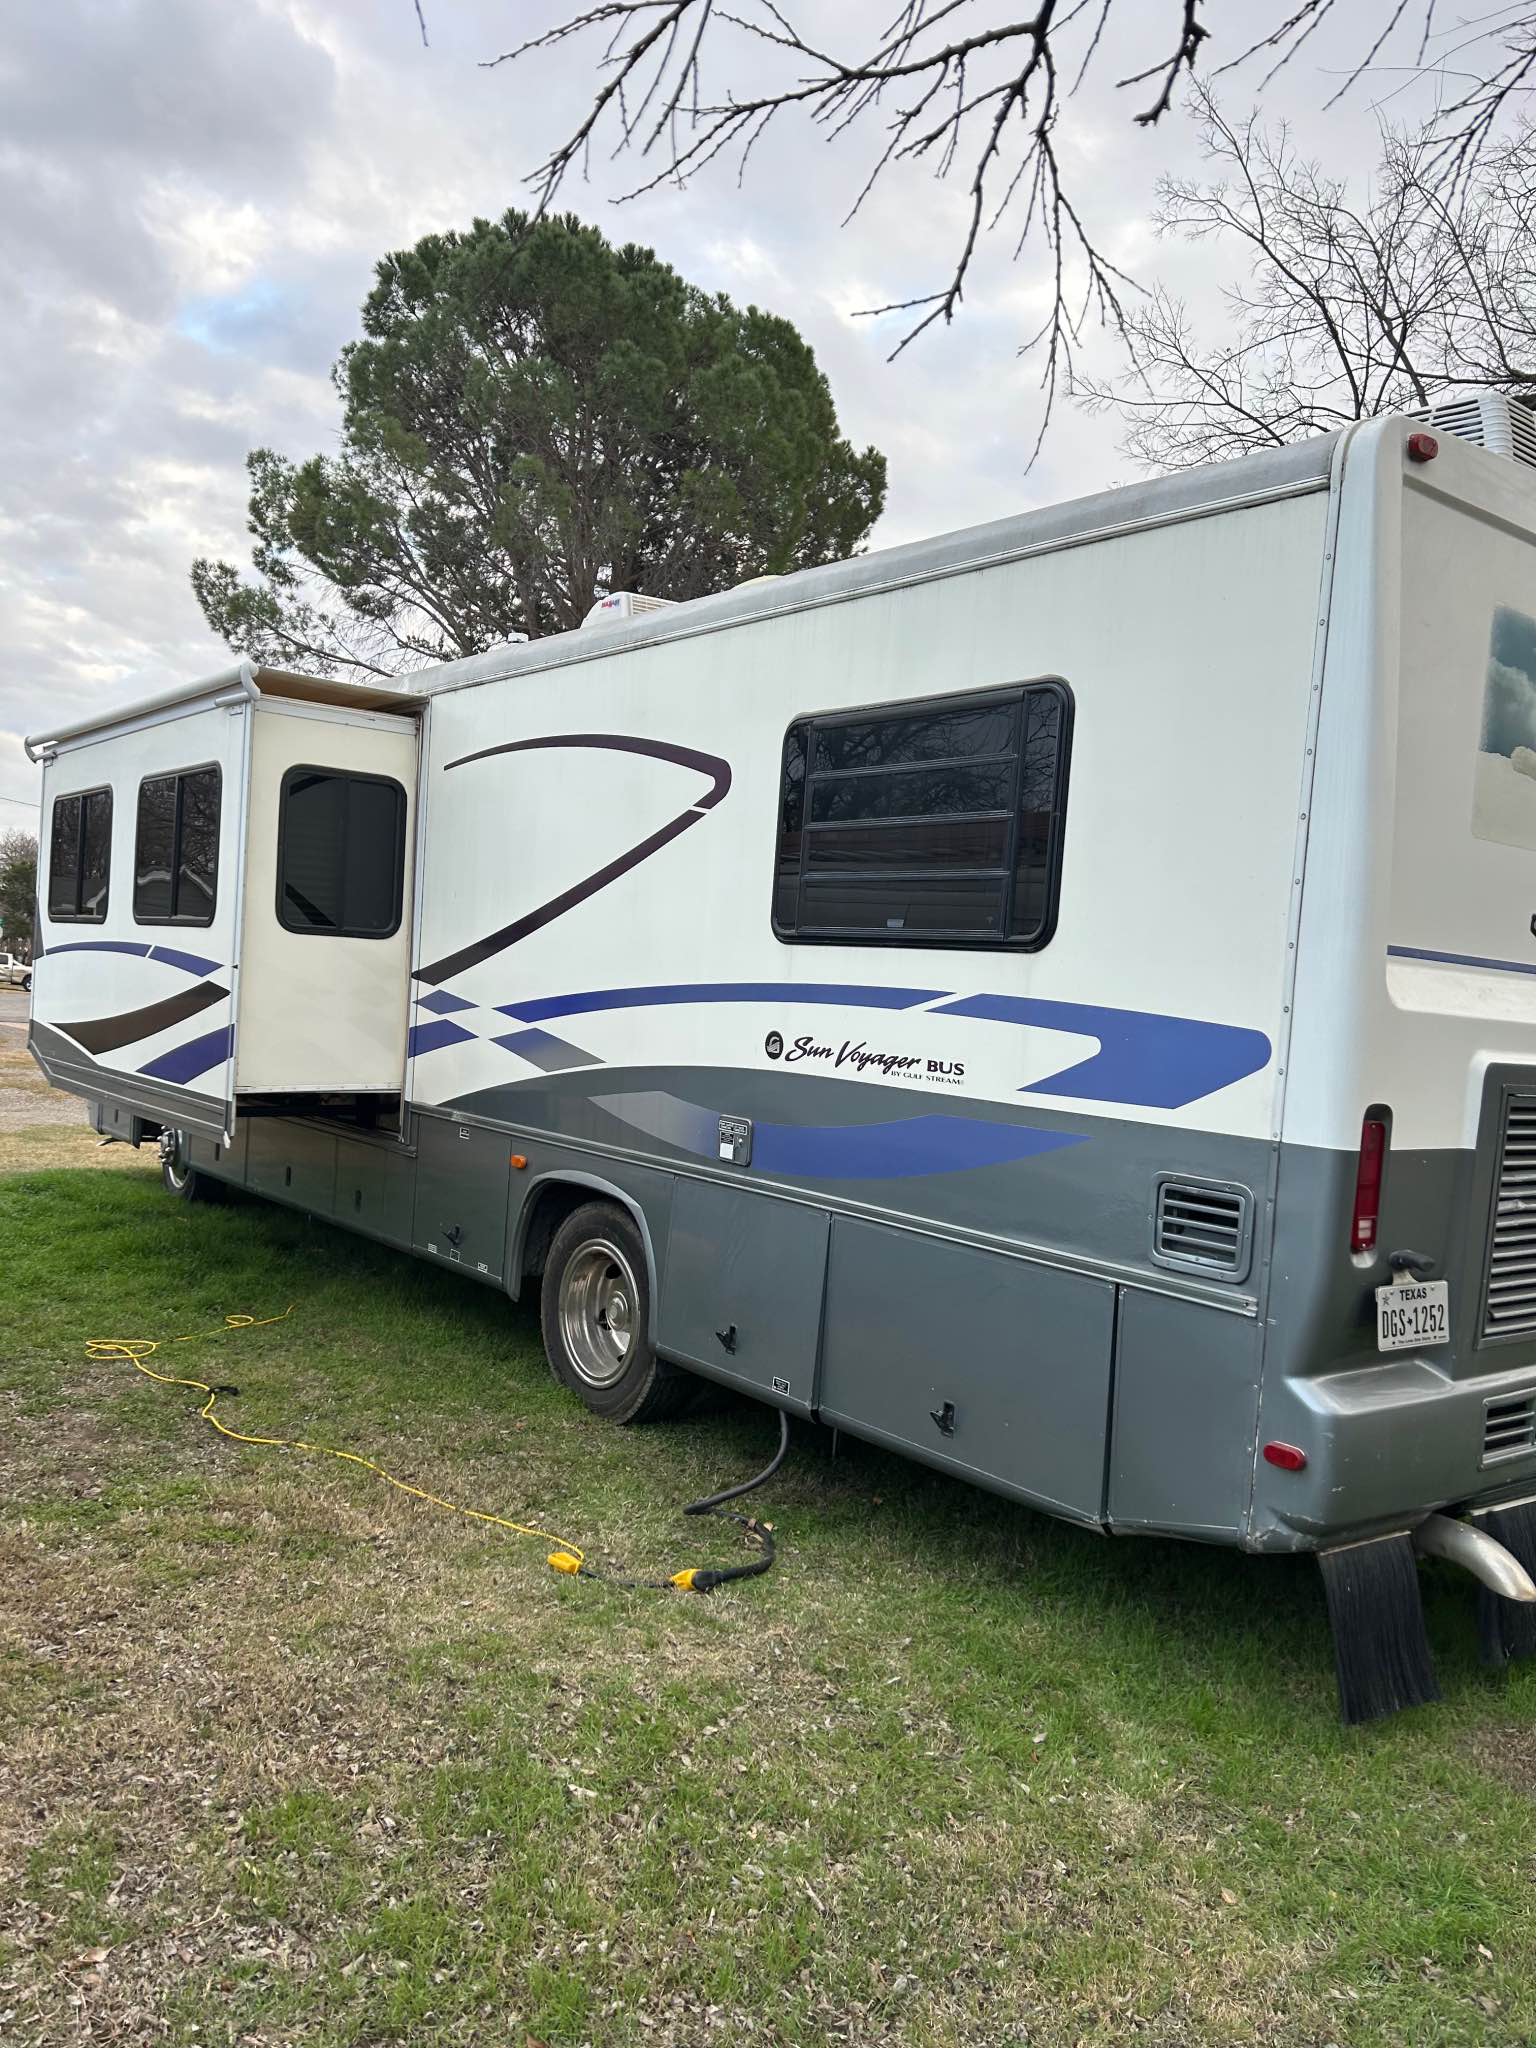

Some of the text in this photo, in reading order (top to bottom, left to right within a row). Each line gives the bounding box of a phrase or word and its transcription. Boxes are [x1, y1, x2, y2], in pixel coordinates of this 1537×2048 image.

[785, 1036, 965, 1076] Sun Voyager BUS
[903, 1072, 922, 1080] GULF
[1400, 1287, 1427, 1301] TEXAS
